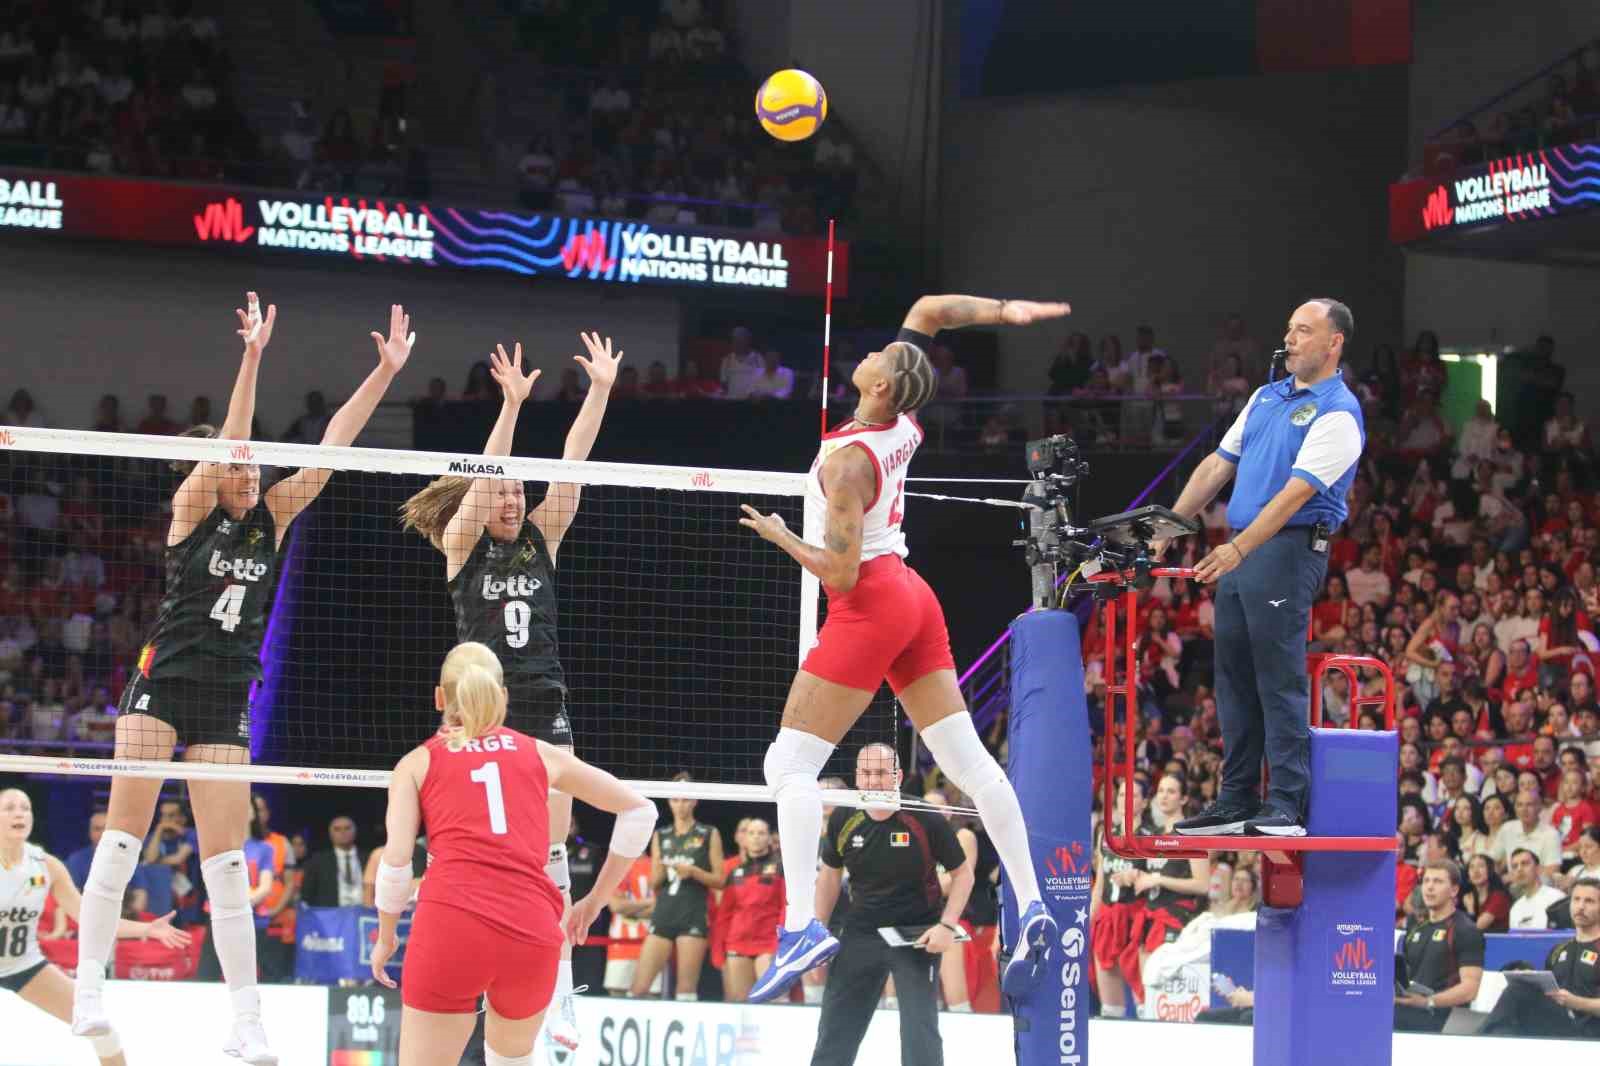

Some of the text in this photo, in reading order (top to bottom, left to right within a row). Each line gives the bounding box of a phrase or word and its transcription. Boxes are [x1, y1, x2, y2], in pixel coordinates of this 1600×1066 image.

[1454, 163, 1550, 203] VOLLEYBALL
[258, 199, 434, 238] VOLLEYBALL
[1454, 188, 1550, 224] NATIONS LEAGUE
[257, 226, 434, 259] NATIONS LEAGUE
[621, 230, 789, 268] VOLLEYBALL
[620, 257, 788, 288] NATIONS LEAGUE
[209, 584, 246, 632] 4
[504, 600, 531, 648] 9
[470, 761, 508, 834] 1
[0, 925, 28, 957] 18
